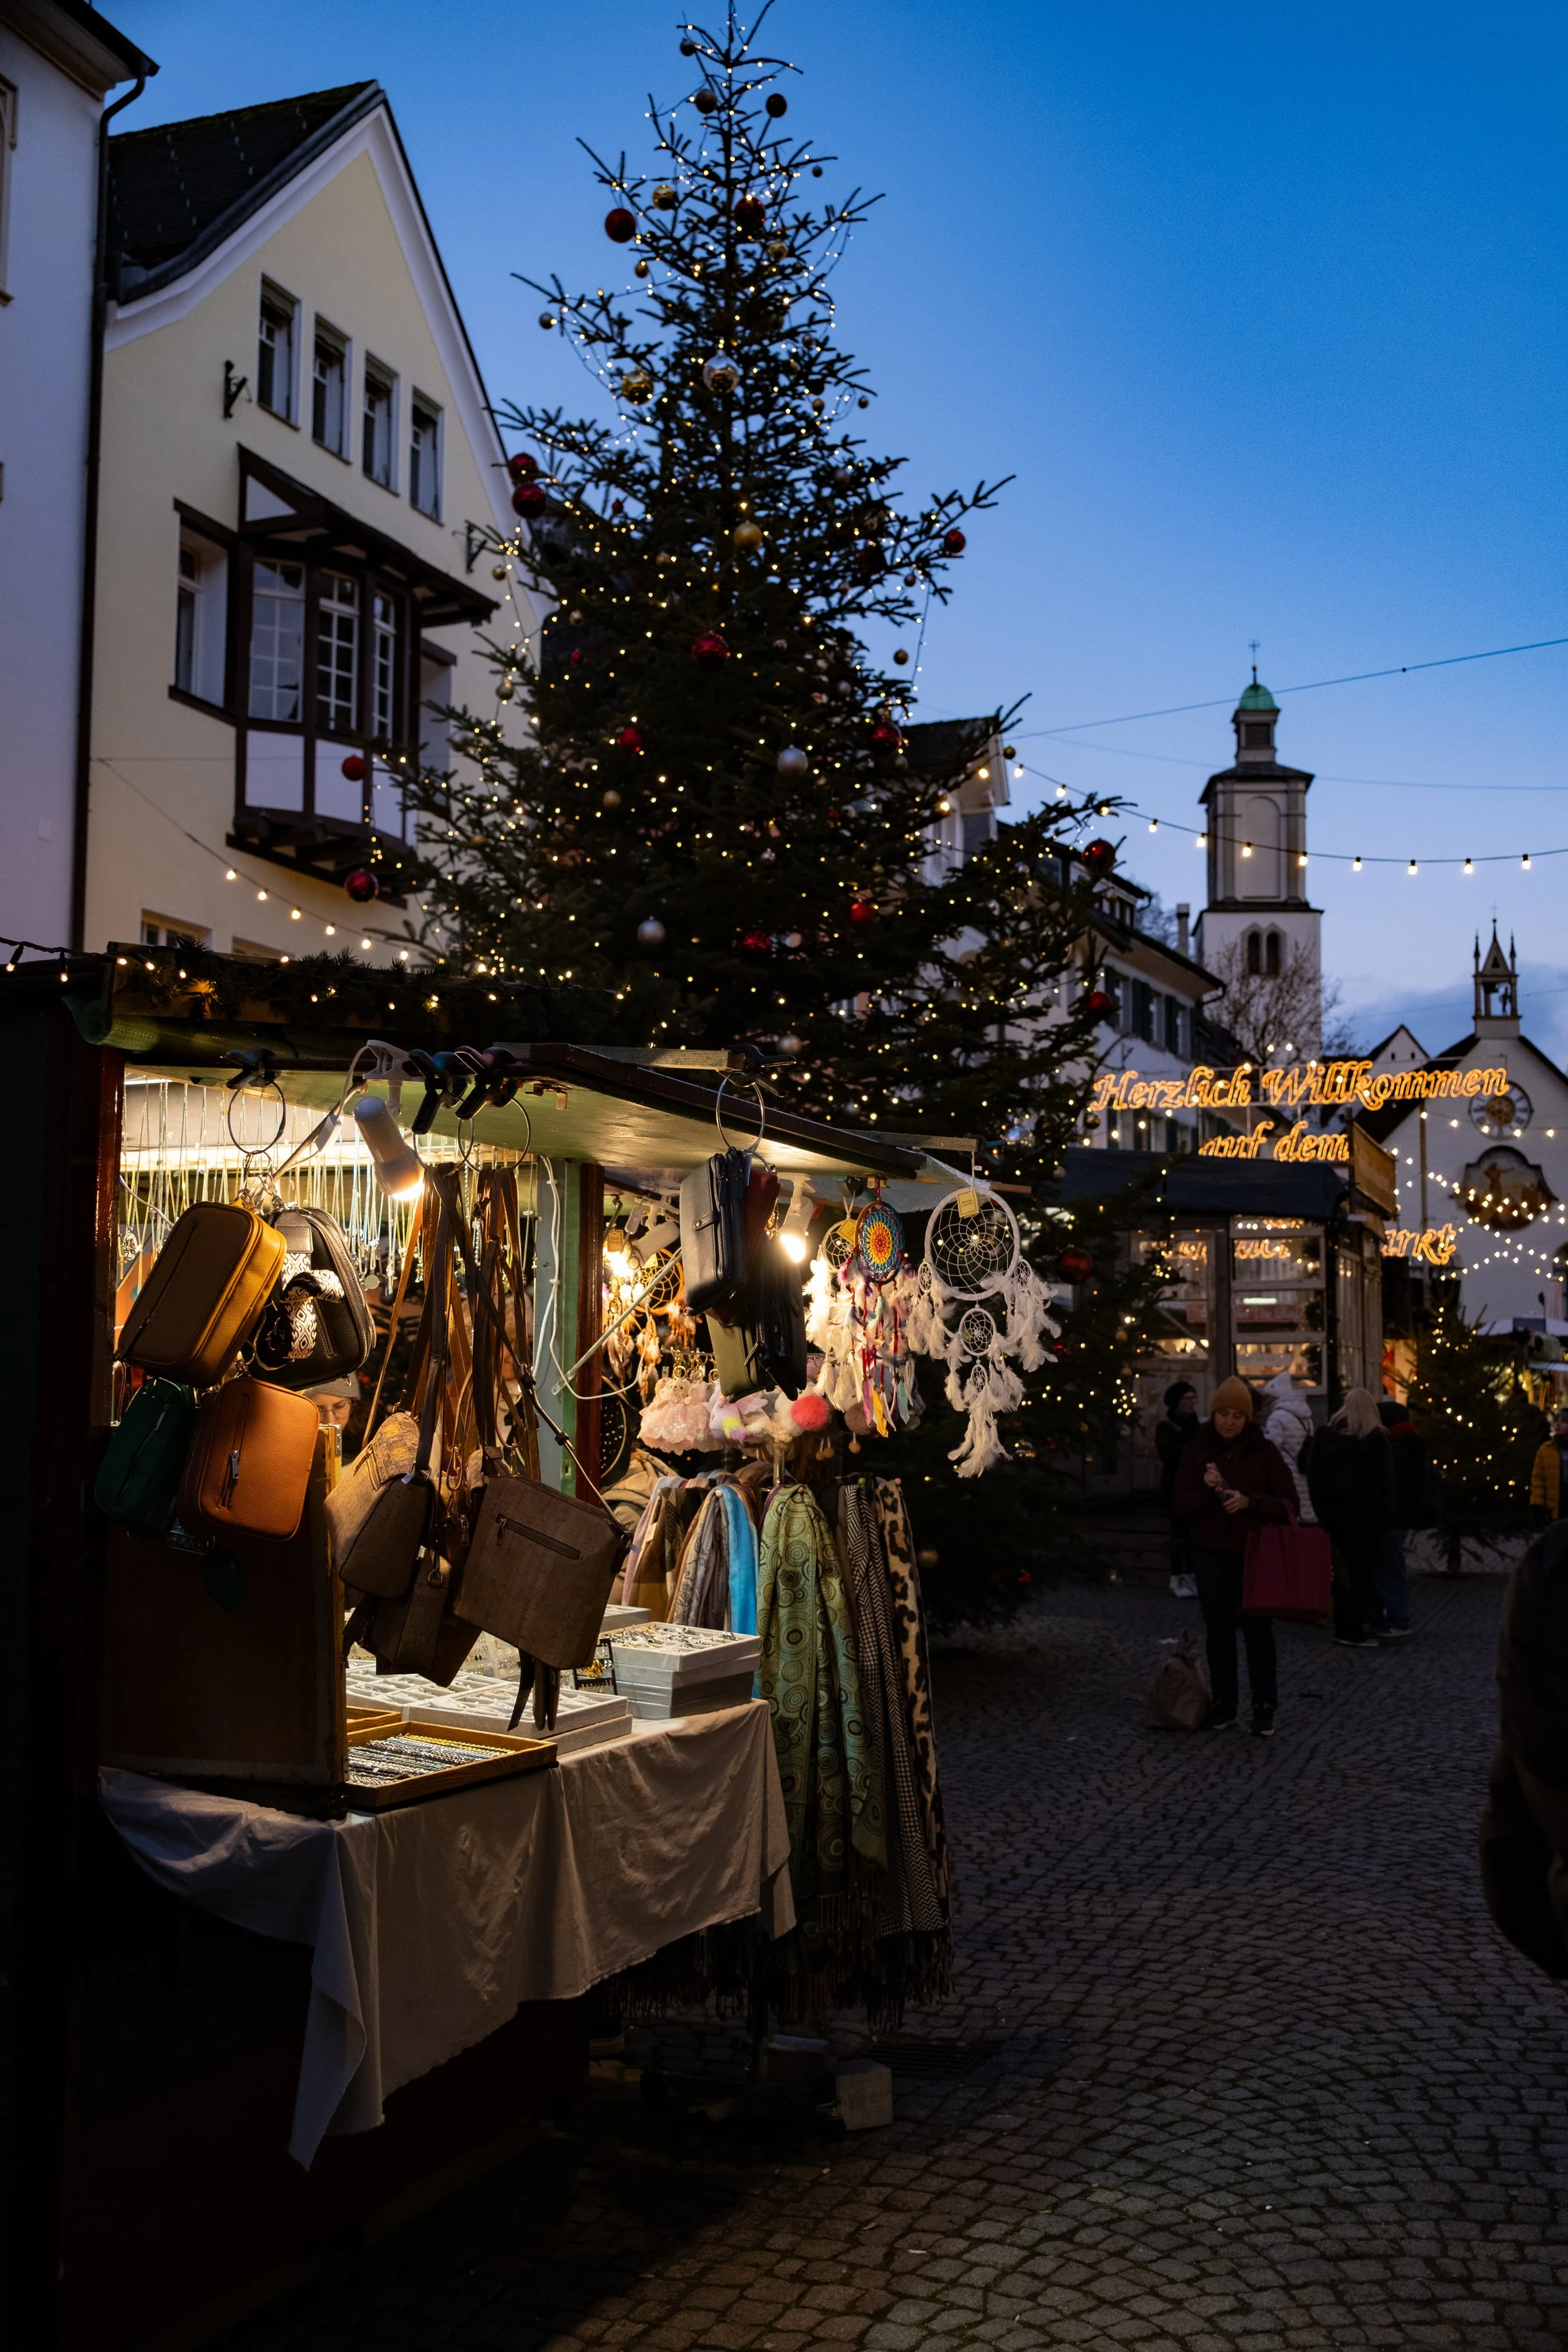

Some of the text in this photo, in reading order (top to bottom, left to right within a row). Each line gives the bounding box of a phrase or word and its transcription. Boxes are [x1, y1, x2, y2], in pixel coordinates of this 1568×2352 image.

[1089, 1061, 1510, 1111] Herzlich Willkommen
[1198, 1120, 1350, 1162] auf dem
